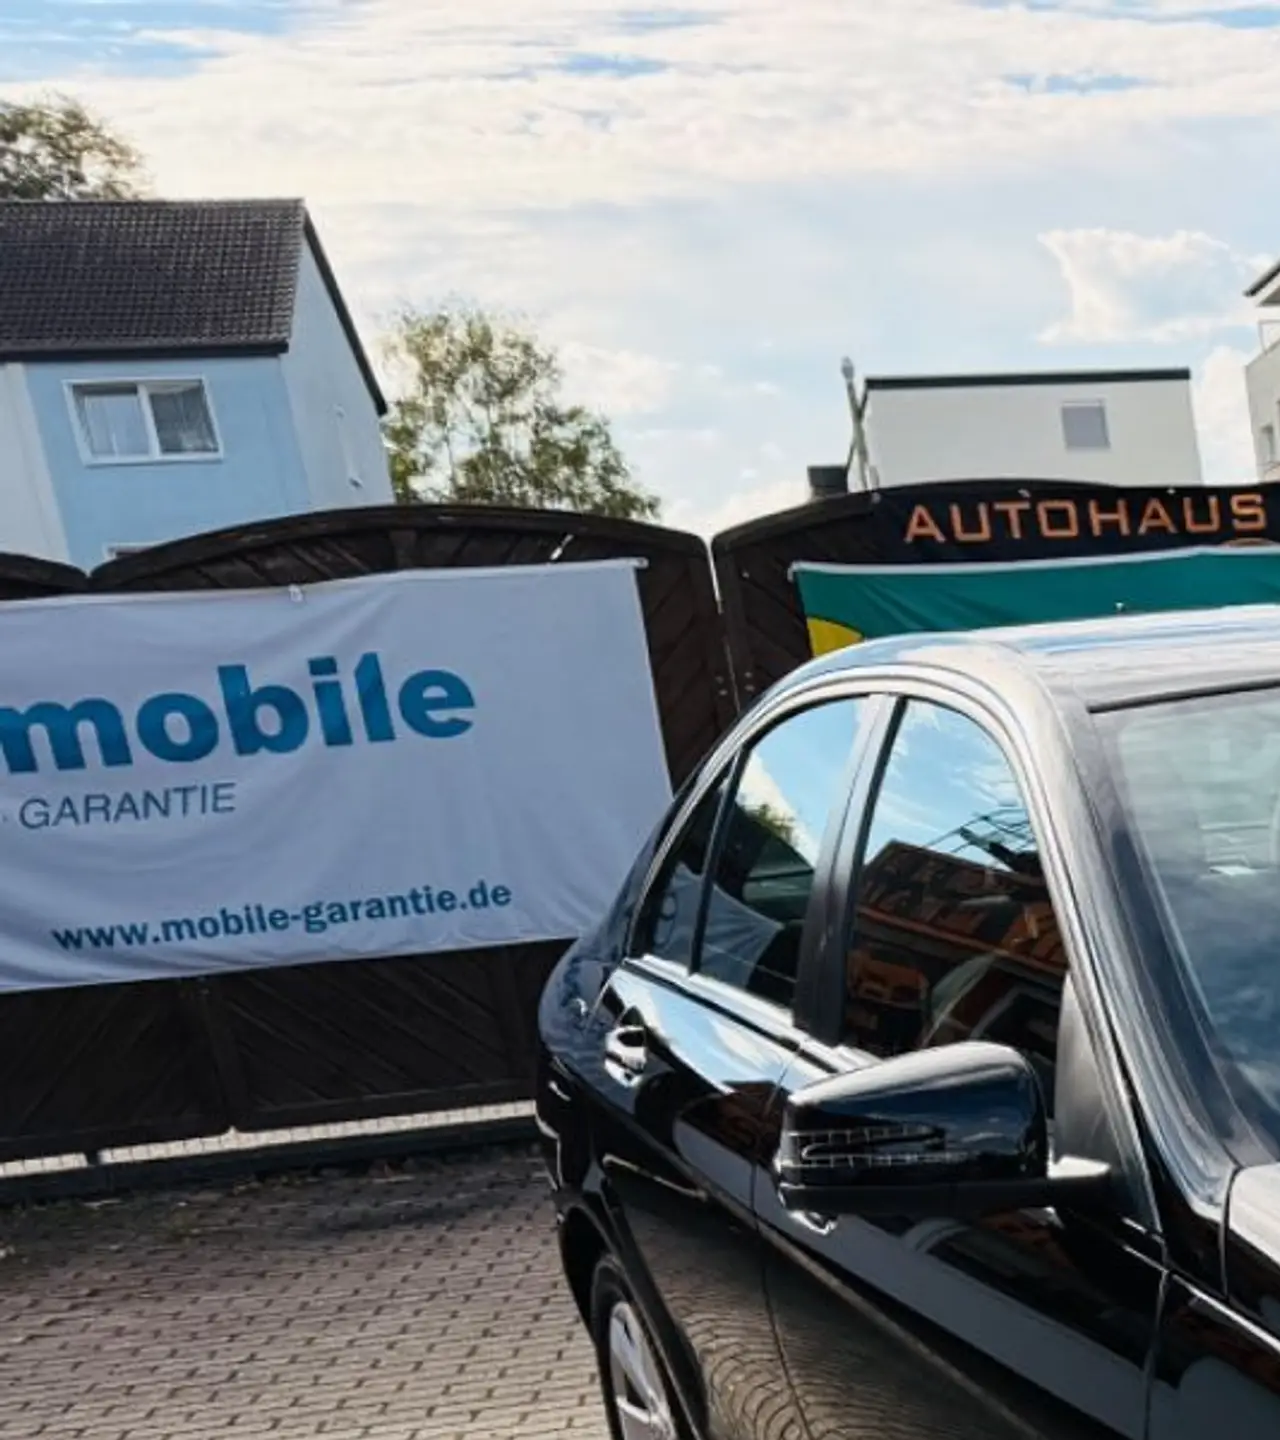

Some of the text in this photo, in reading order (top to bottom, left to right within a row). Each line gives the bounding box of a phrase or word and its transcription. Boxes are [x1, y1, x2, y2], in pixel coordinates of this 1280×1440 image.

[904, 493, 1267, 545] AUTOHAUS
[0, 652, 476, 774] mobile
[19, 782, 236, 829] GARANTIE
[51, 880, 512, 952] www.mobile-garantie.de
